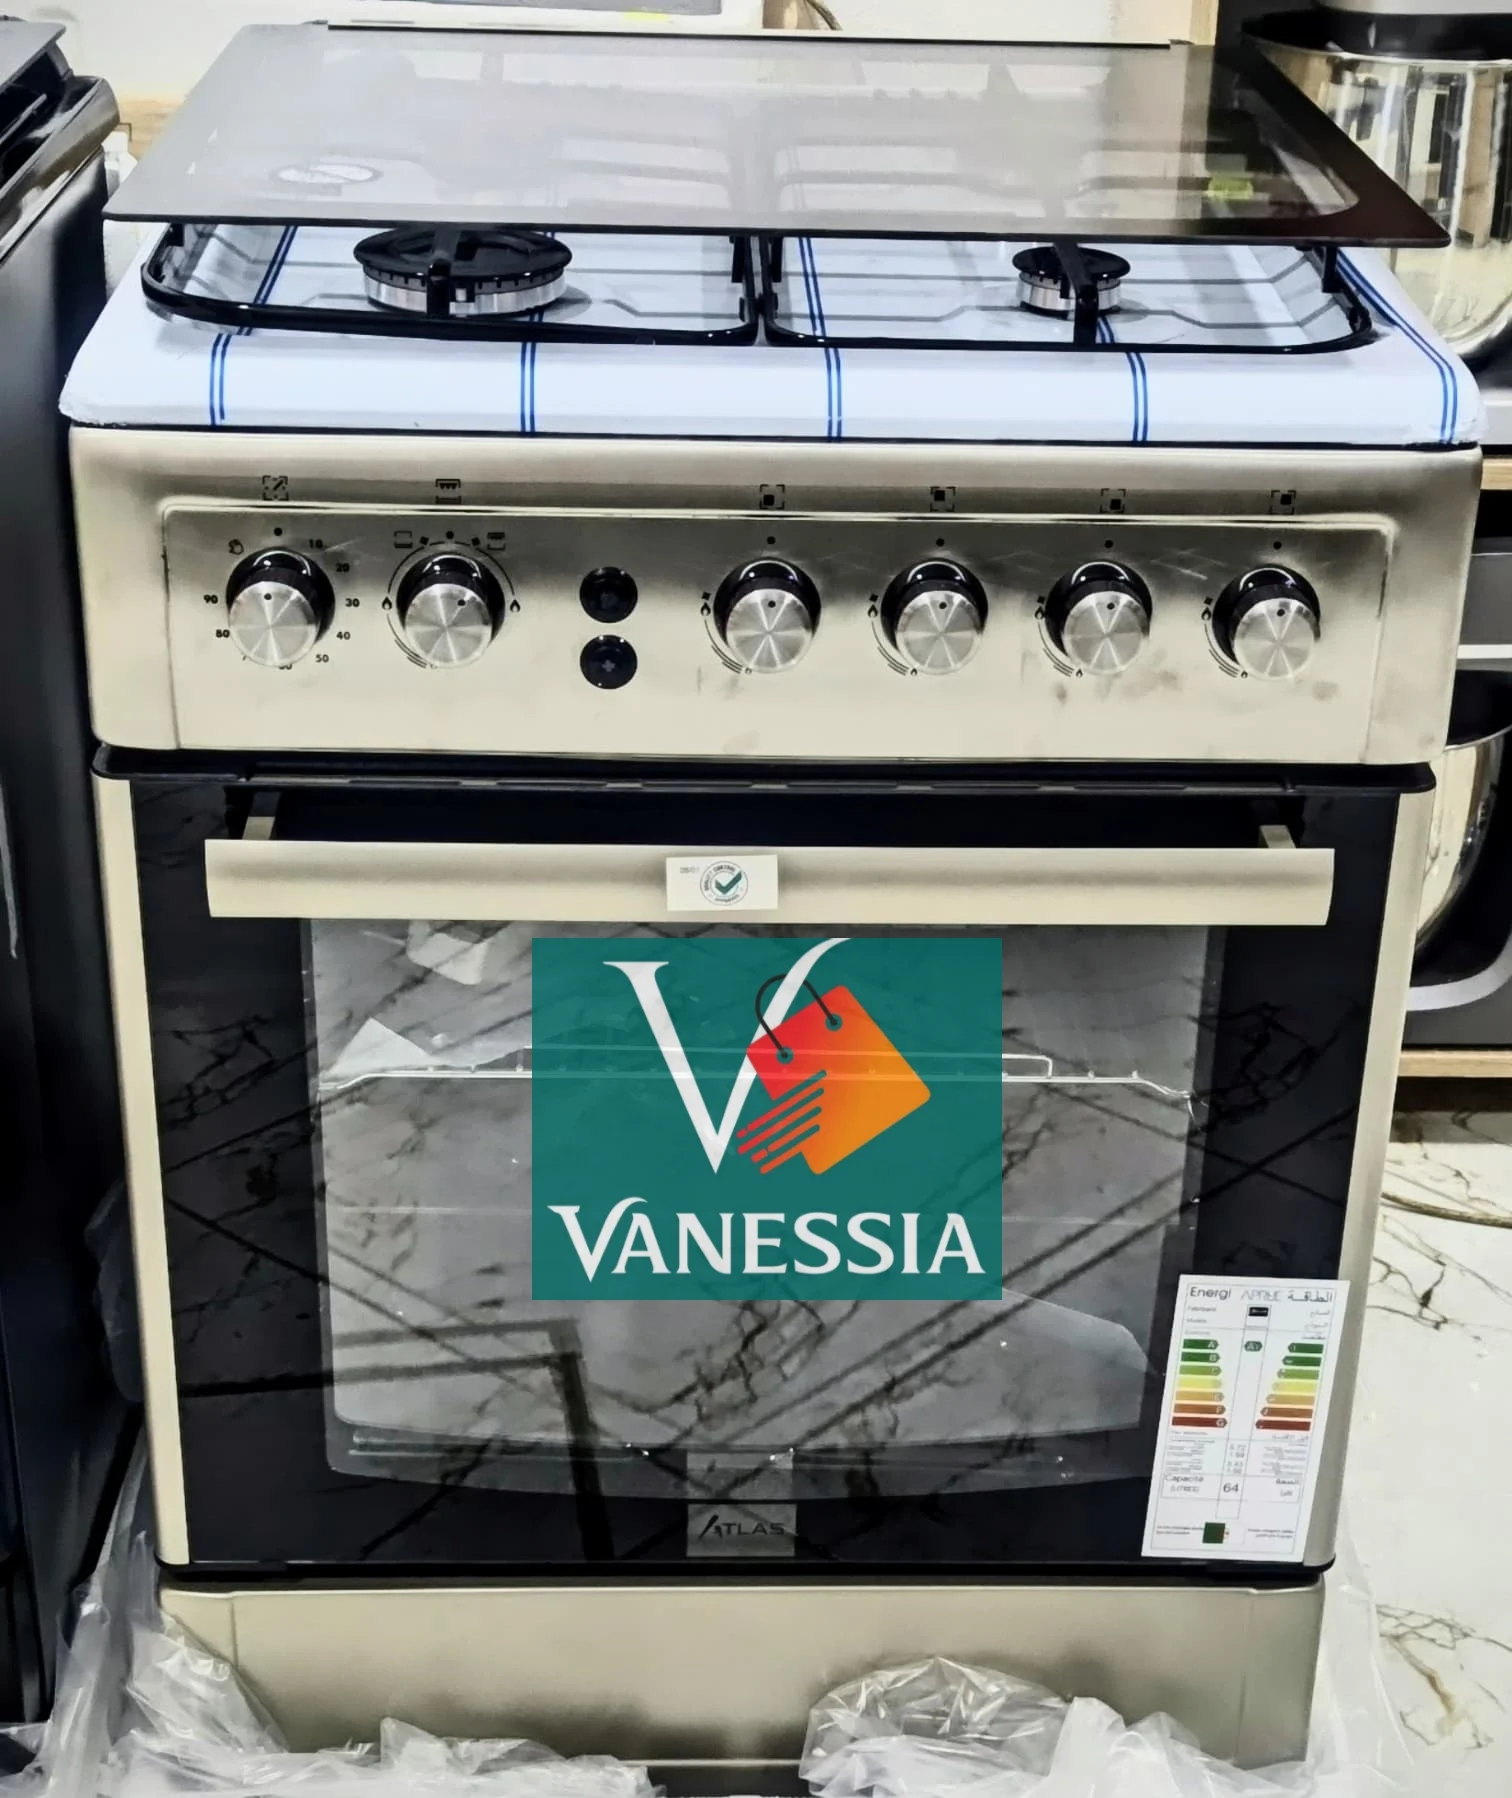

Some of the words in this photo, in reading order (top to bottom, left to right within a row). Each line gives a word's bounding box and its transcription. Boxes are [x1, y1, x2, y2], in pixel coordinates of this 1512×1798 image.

[308, 539, 324, 549] 10
[335, 563, 350, 573] 20
[203, 594, 219, 604] 90
[345, 598, 360, 608] 30
[215, 629, 231, 639] 80
[336, 631, 351, 641] 40
[315, 654, 330, 664] 50
[1222, 1482, 1239, 1493] 64
[698, 1513, 786, 1540] ATLAS
